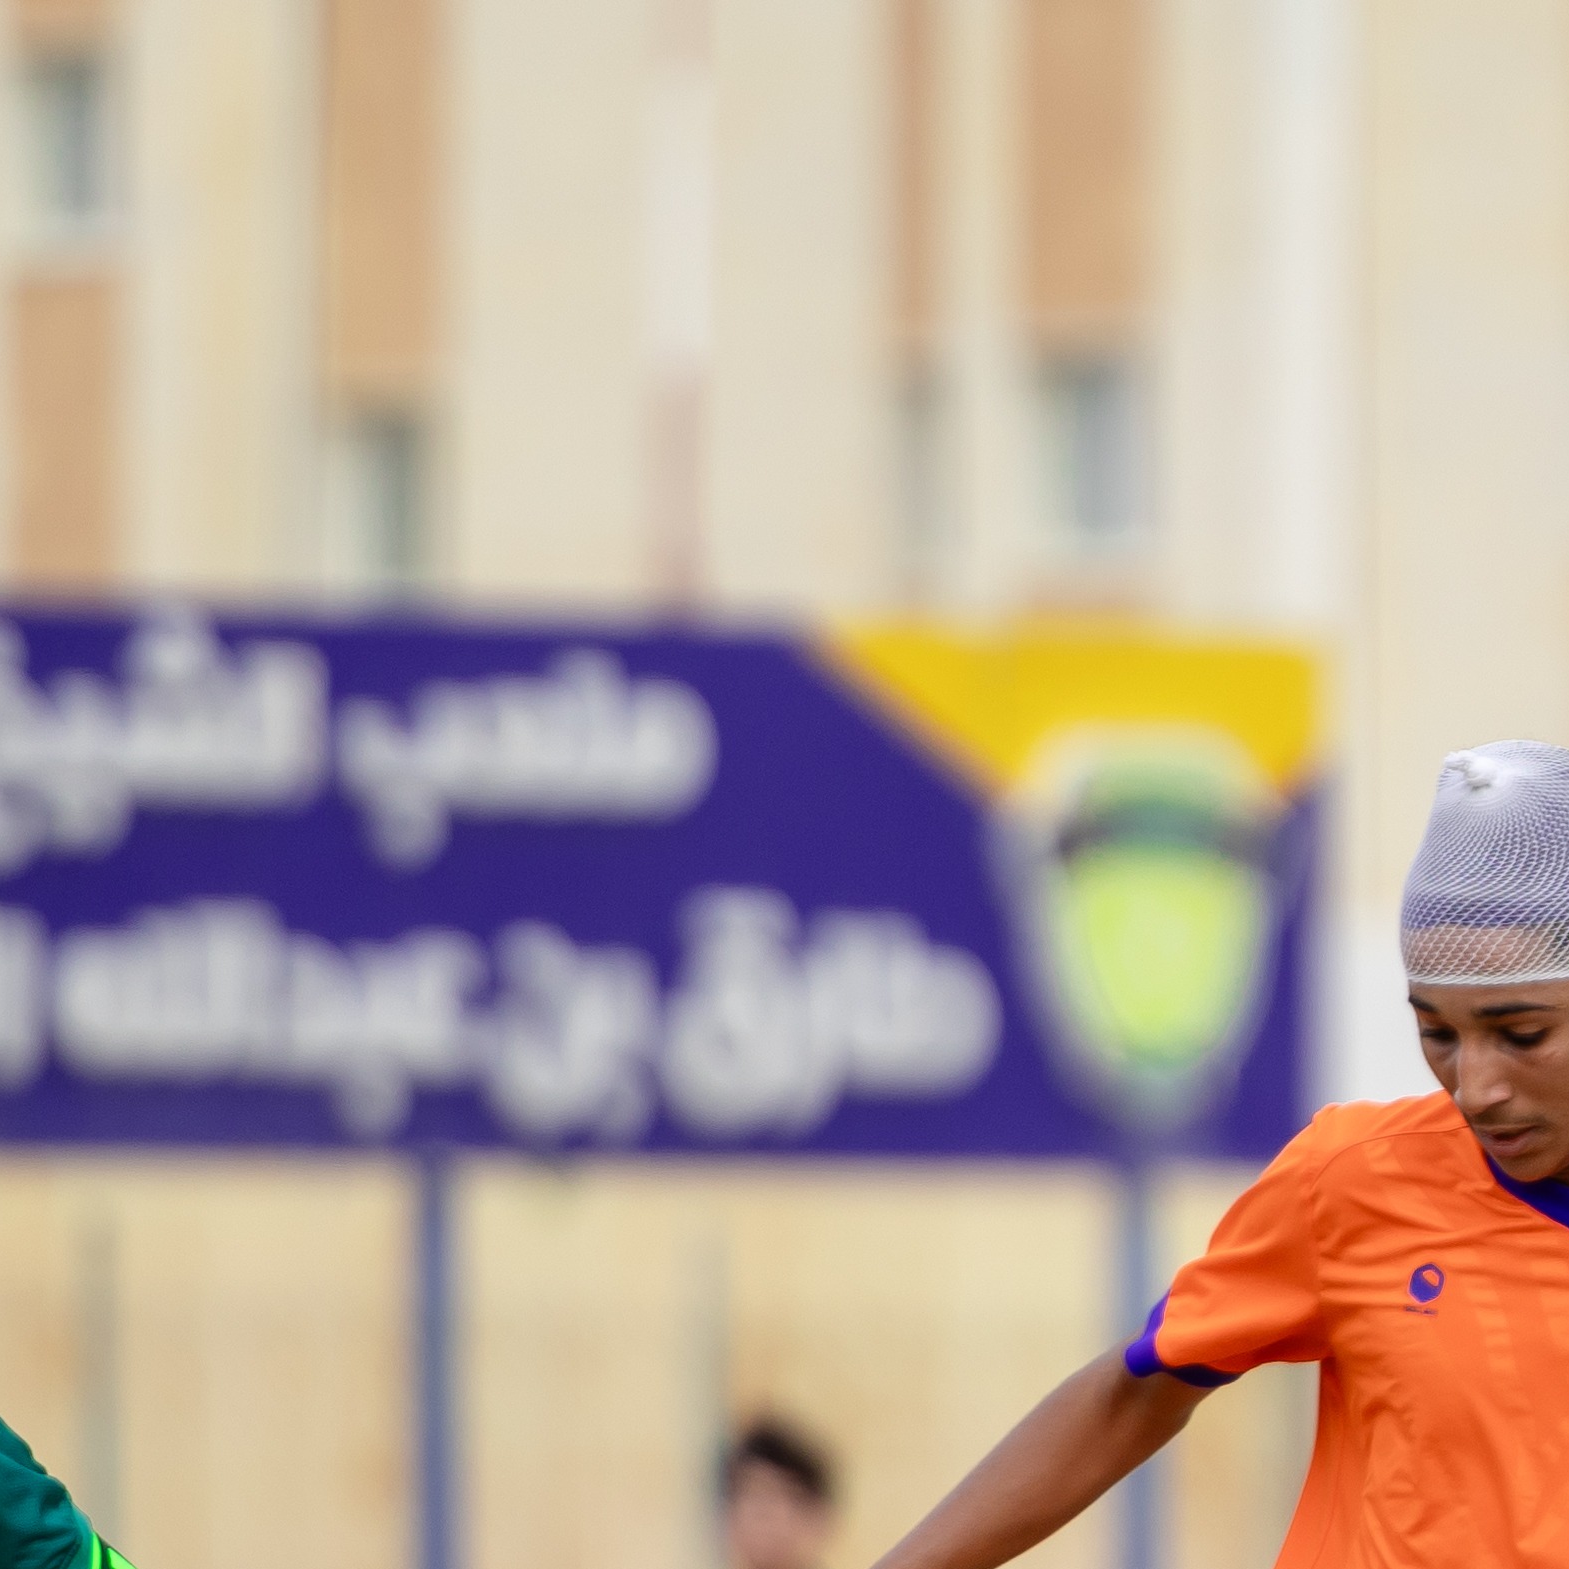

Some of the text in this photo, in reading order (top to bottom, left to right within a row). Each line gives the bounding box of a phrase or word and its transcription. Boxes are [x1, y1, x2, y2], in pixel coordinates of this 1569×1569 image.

[337, 650, 717, 868] ملعب
[477, 914, 659, 1144] بن
[657, 886, 1001, 1136] طارق
